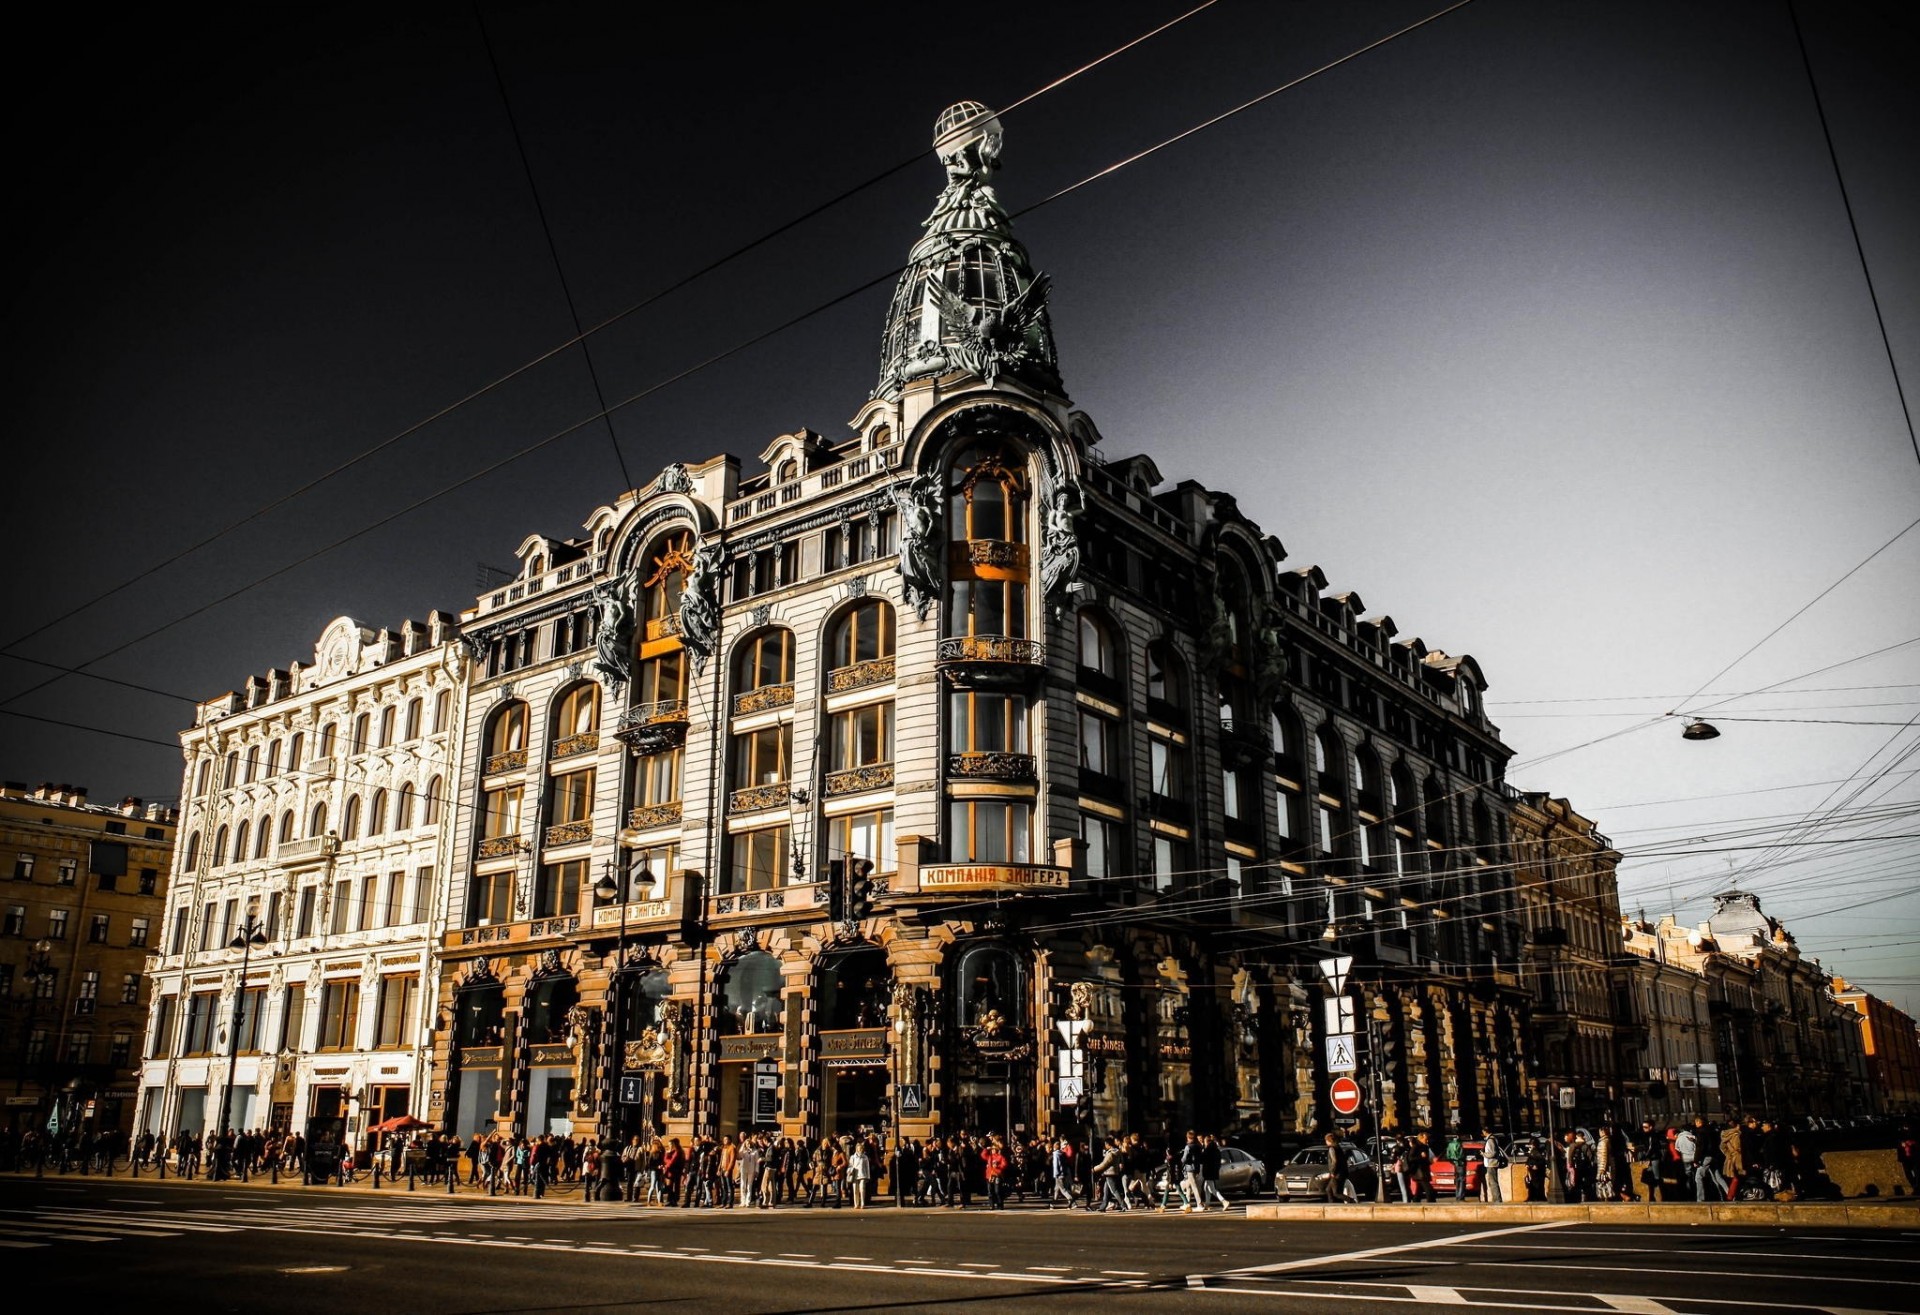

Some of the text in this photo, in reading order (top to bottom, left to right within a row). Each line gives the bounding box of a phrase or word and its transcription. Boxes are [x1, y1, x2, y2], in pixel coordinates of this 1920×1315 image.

[927, 868, 1062, 885] КОМПАНІЯ ЗИНГЕРЪ
[598, 907, 632, 922] КОМПАІЯ
